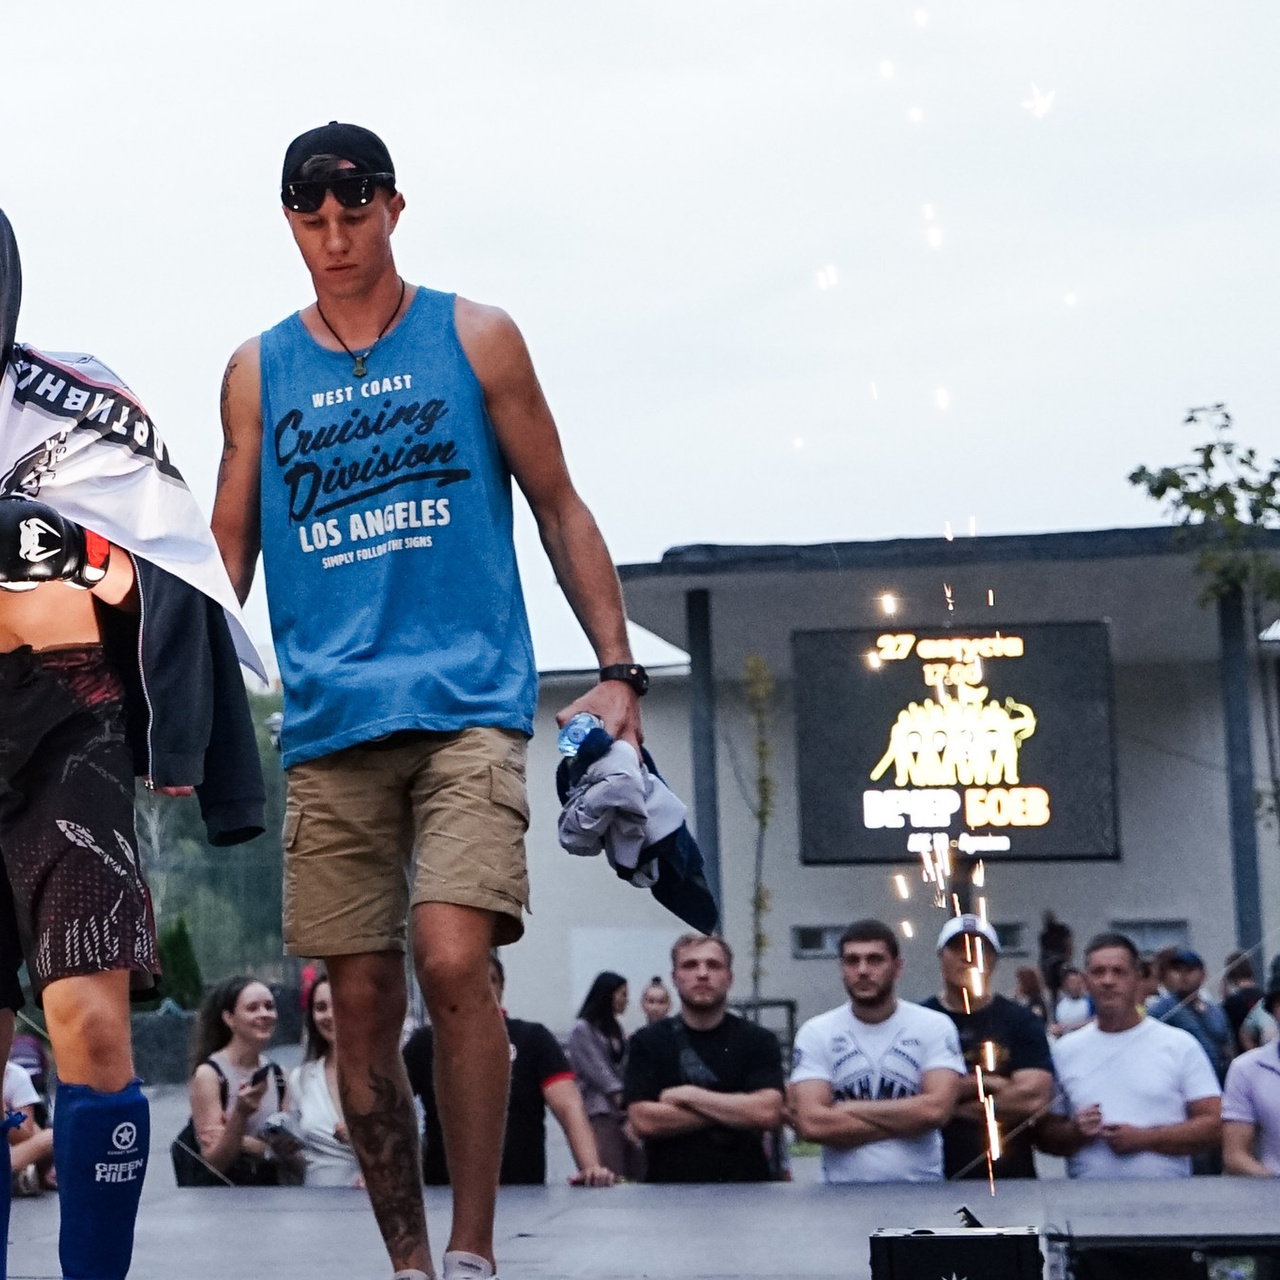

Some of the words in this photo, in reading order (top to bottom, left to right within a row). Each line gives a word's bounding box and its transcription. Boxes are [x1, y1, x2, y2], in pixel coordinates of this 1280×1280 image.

[312, 386, 353, 408] WEST
[361, 374, 412, 398] COAST
[274, 395, 449, 467] Cruising
[283, 437, 458, 524] Division
[299, 518, 342, 554] LOS
[350, 498, 451, 541] ANGELES
[322, 551, 354, 569] SIMPLY
[404, 536, 433, 549] SIGNS
[876, 633, 916, 660] 27
[95, 1158, 144, 1172] GREEN
[95, 1169, 137, 1183] HILL
